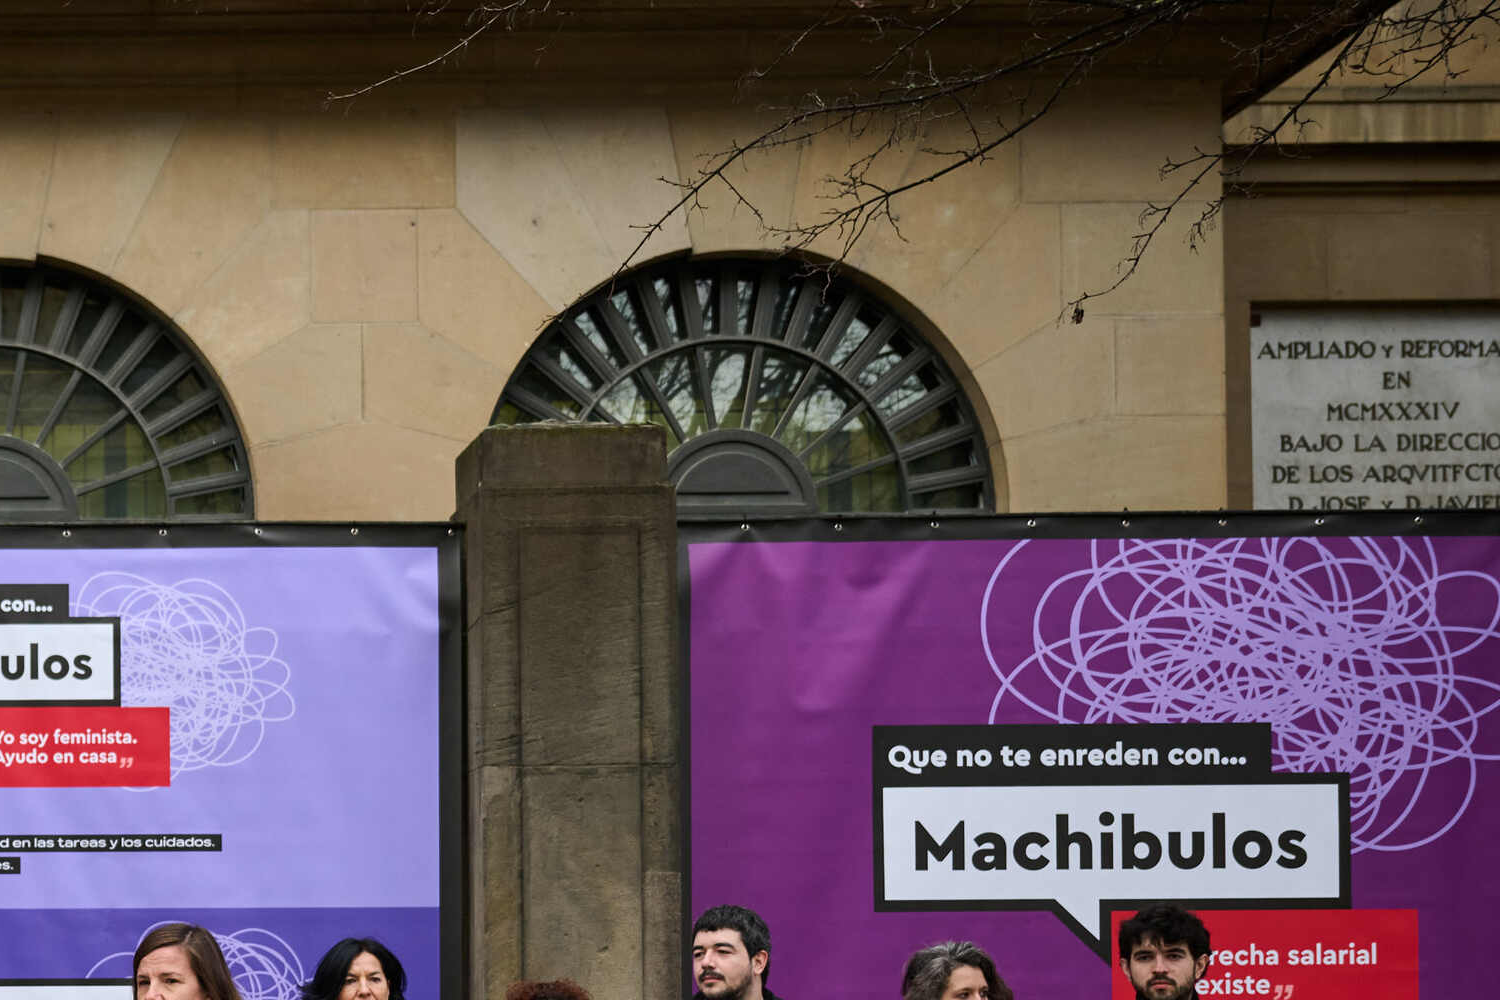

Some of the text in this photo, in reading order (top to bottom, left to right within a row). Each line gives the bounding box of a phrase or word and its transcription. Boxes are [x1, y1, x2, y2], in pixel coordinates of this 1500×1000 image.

[1257, 340, 1376, 360] AMPLIADO
[1382, 371, 1411, 390] EN
[1326, 401, 1460, 421] MCMXXXIV
[1279, 433, 1343, 452] BAJO
[1354, 434, 1386, 452] LA
[1271, 465, 1300, 484] DE
[1309, 464, 1353, 483] LOS
[1429, 495, 1500, 510] JAVIE
[0, 596, 54, 613] con...
[19, 731, 49, 748] soy
[53, 728, 138, 745] feminista.
[53, 751, 74, 765] en
[888, 741, 1247, 774] Que no te enreden con...
[12, 838, 34, 848] en
[34, 837, 54, 848] las
[58, 837, 107, 849] tareas
[109, 838, 118, 850] y
[121, 836, 142, 848] los
[145, 836, 216, 848] cuidados.
[914, 811, 1308, 871] Machibulos
[1287, 942, 1378, 965] salarial
